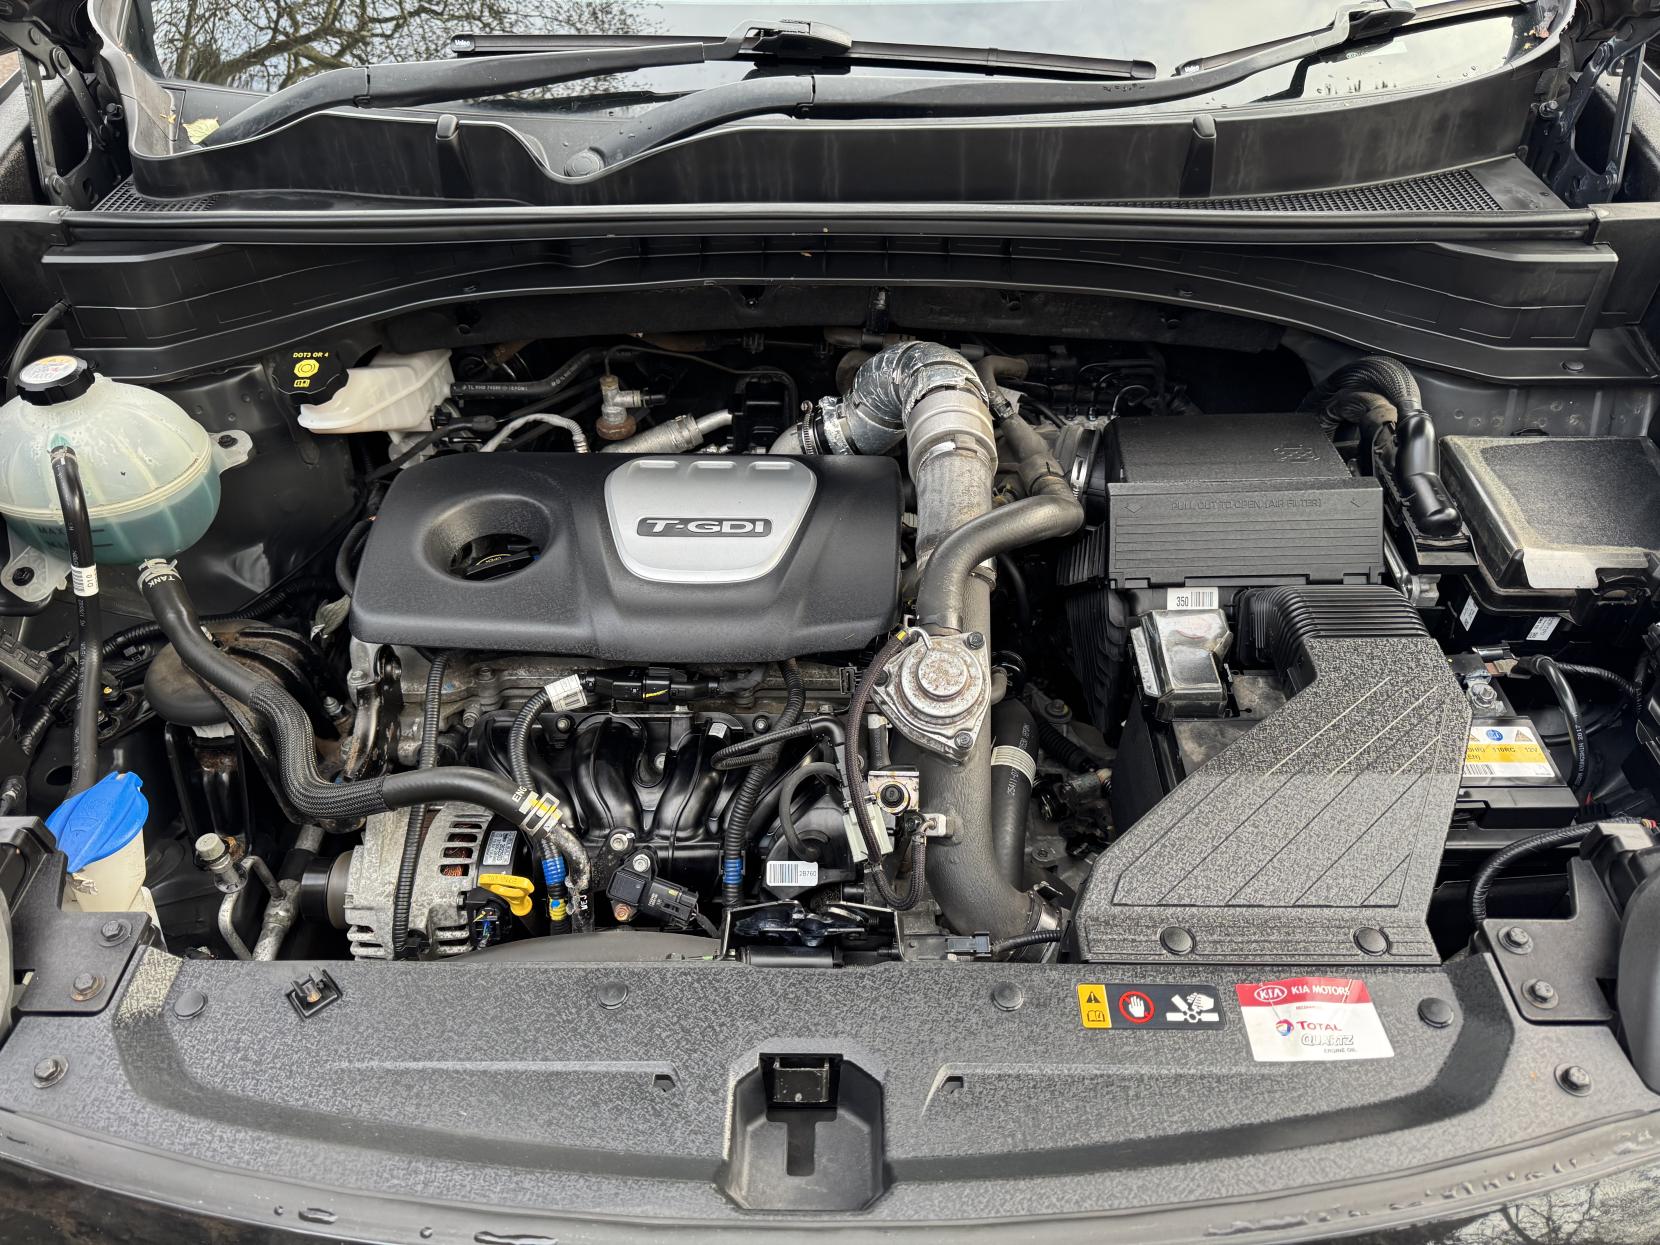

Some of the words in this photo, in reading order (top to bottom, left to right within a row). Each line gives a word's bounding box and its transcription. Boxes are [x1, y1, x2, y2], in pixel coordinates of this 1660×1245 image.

[646, 519, 765, 533] T-GDI
[147, 575, 176, 589] TANK
[1176, 596, 1189, 607] 350
[511, 785, 528, 803] ENG
[1259, 986, 1284, 1000] KIA
[1291, 985, 1310, 995] KIA
[1296, 1020, 1343, 1032] TOTAL
[1301, 1033, 1355, 1047] QUARTZ
